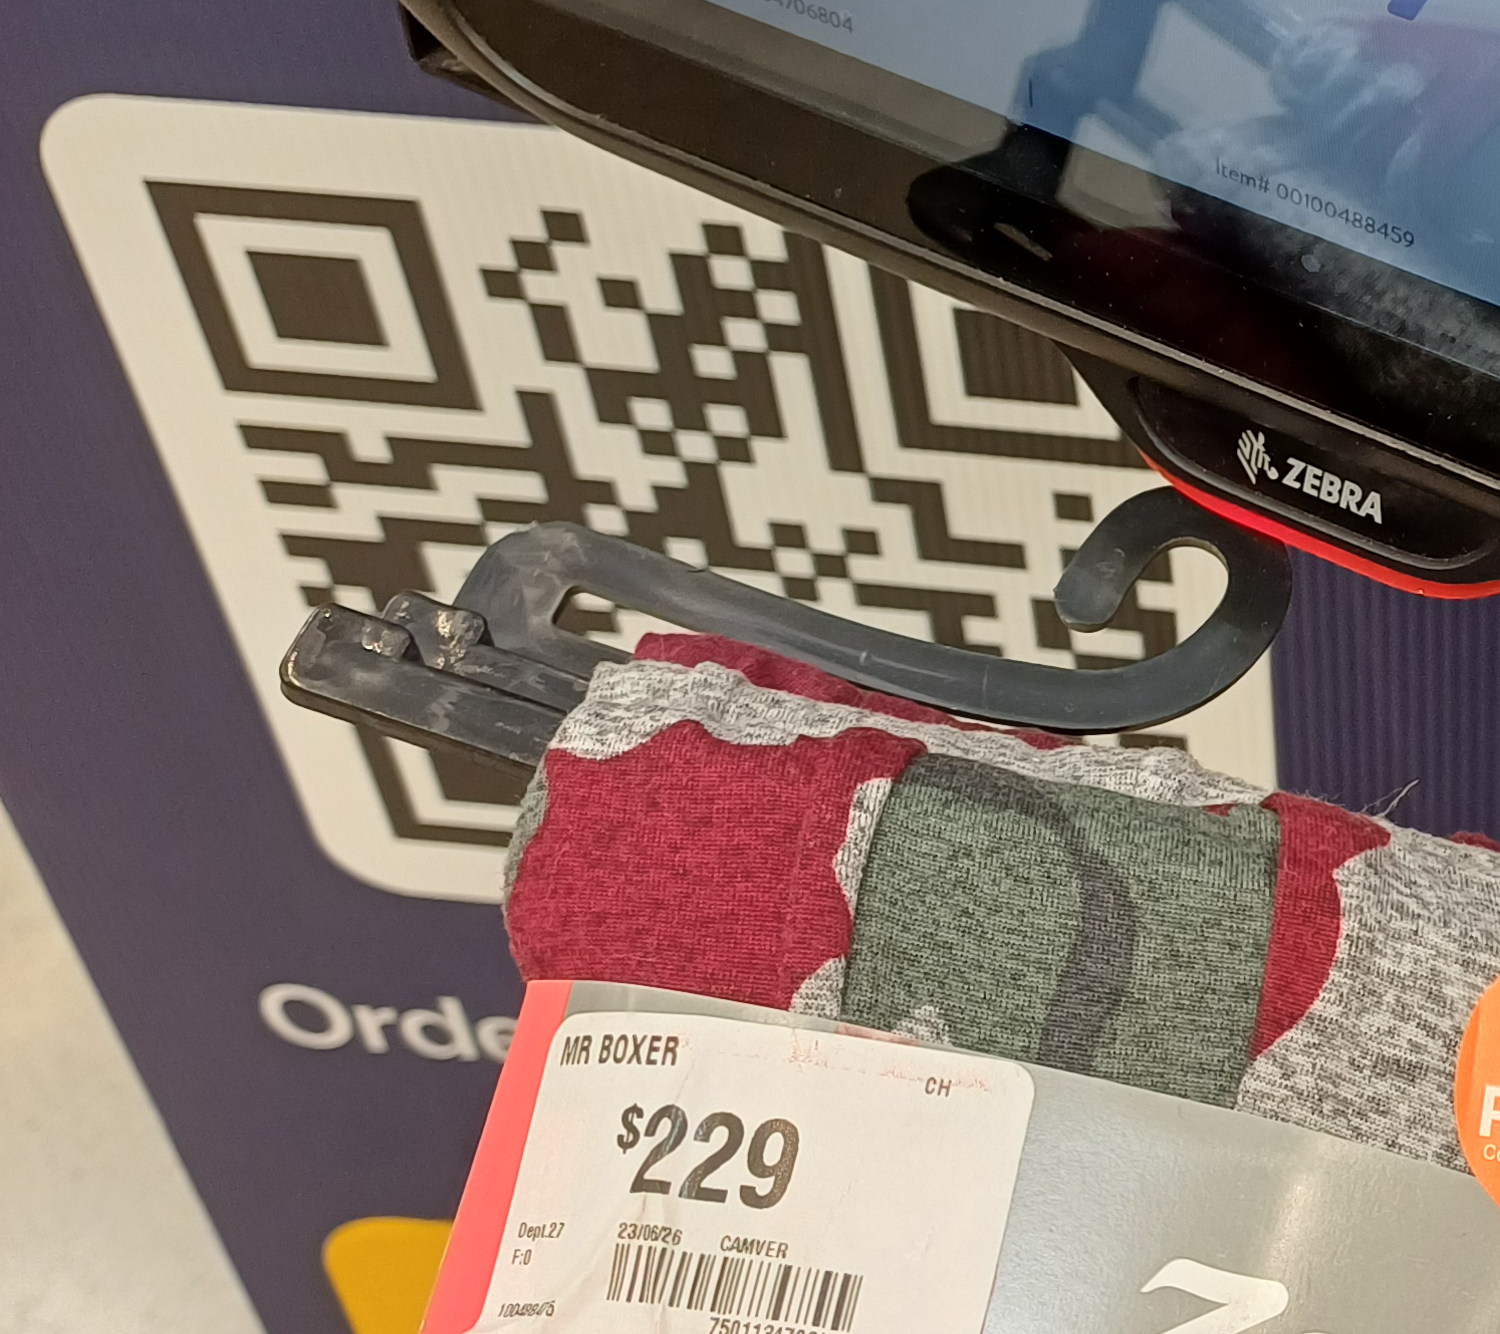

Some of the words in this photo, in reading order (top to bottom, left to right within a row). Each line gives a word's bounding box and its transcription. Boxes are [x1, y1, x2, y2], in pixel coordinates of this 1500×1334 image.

[1215, 156, 1270, 194] Item#
[1276, 182, 1415, 249] 00100488459
[1281, 456, 1384, 525] ZEBRA
[560, 1035, 592, 1067] MR
[599, 1034, 680, 1067] BOXER
[924, 1075, 953, 1098] CH
[616, 1102, 802, 1210] $229
[617, 1222, 683, 1246] 23/06/26
[720, 1234, 789, 1259] CAMVER
